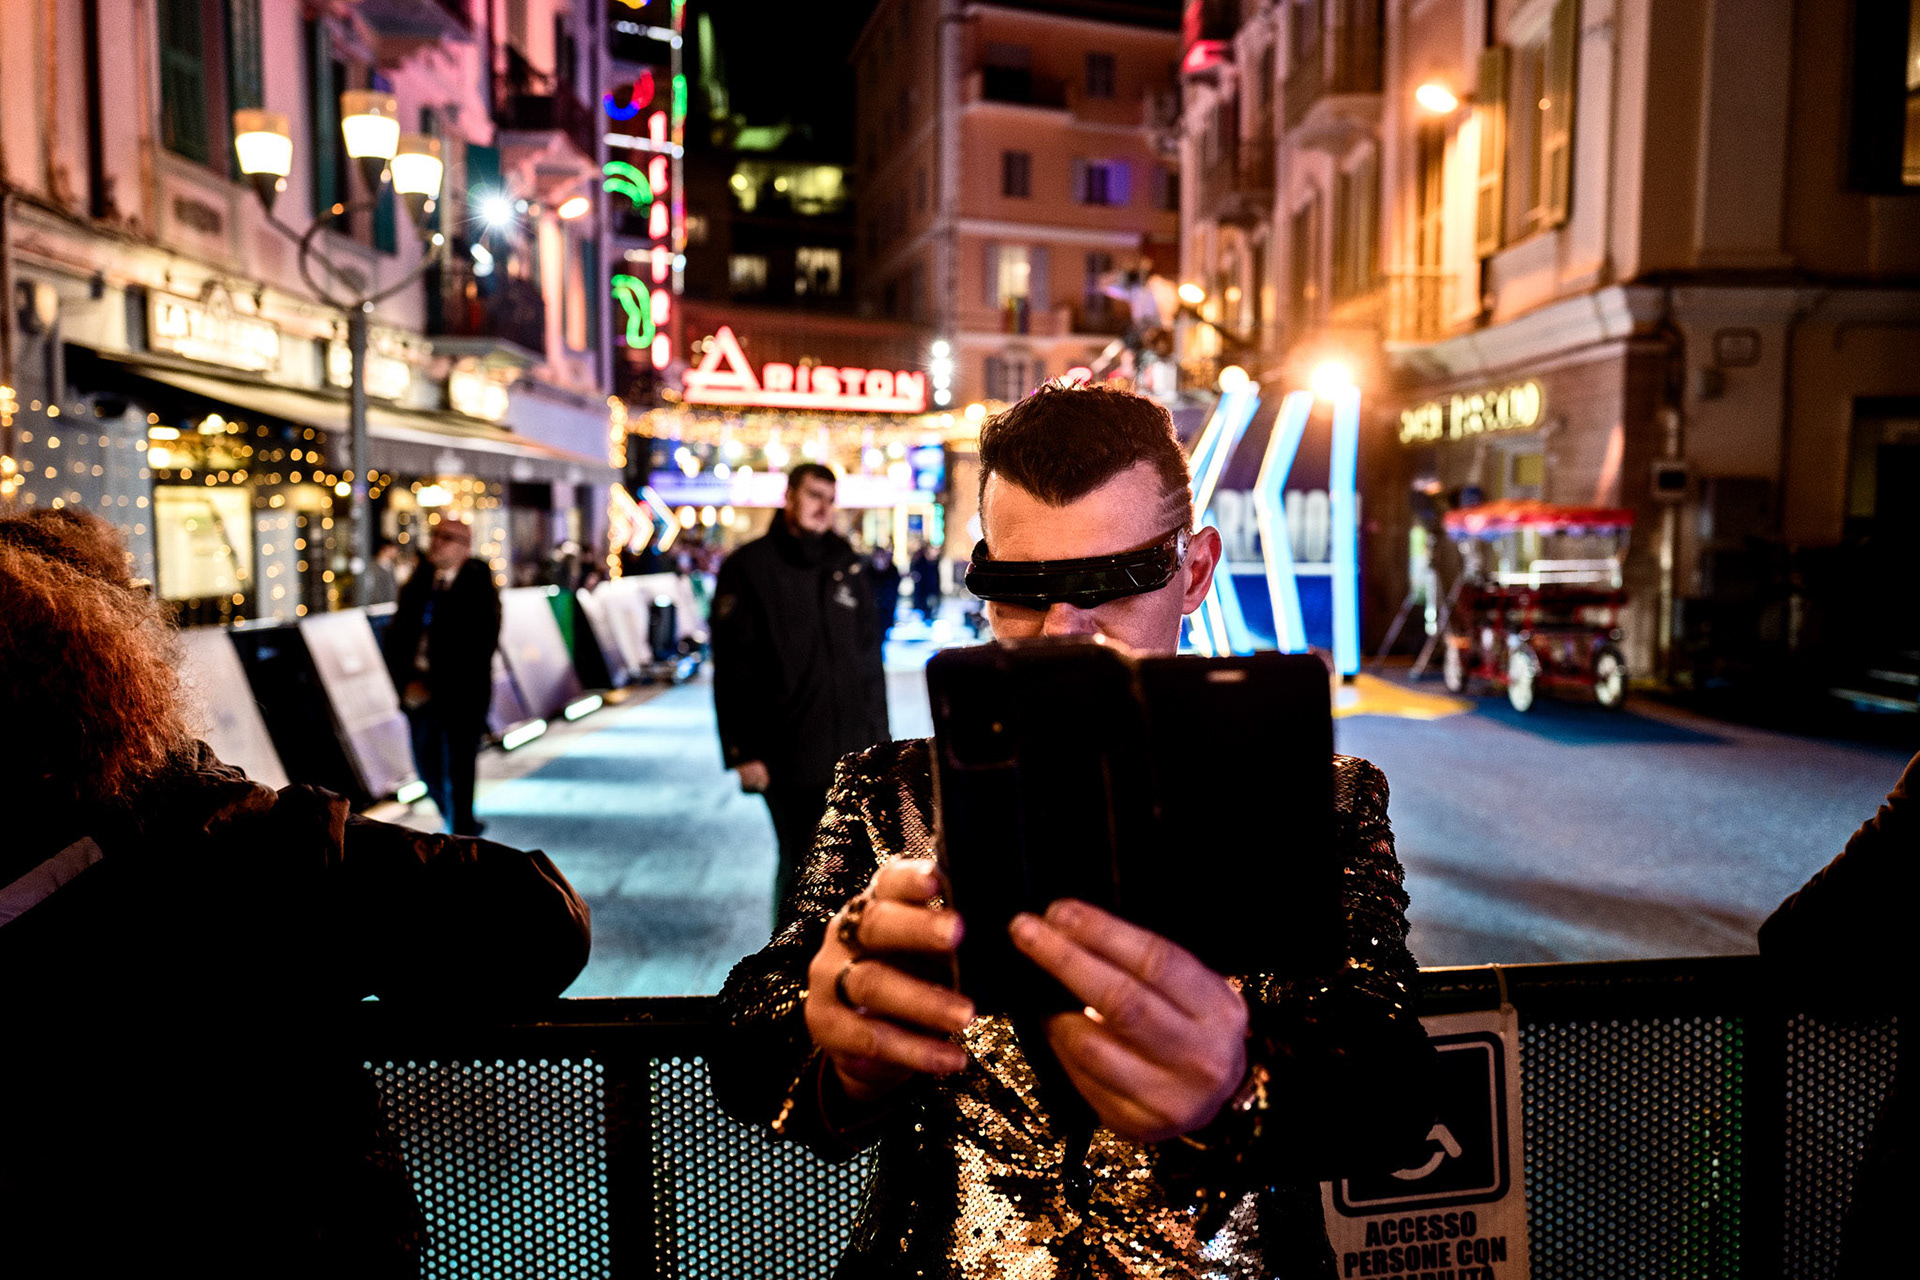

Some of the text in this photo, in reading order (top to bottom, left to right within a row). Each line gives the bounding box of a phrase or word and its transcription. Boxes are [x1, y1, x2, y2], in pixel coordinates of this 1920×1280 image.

[1365, 1211, 1477, 1248] ACCESSO
[1344, 1236, 1507, 1278] PERSONE CON
